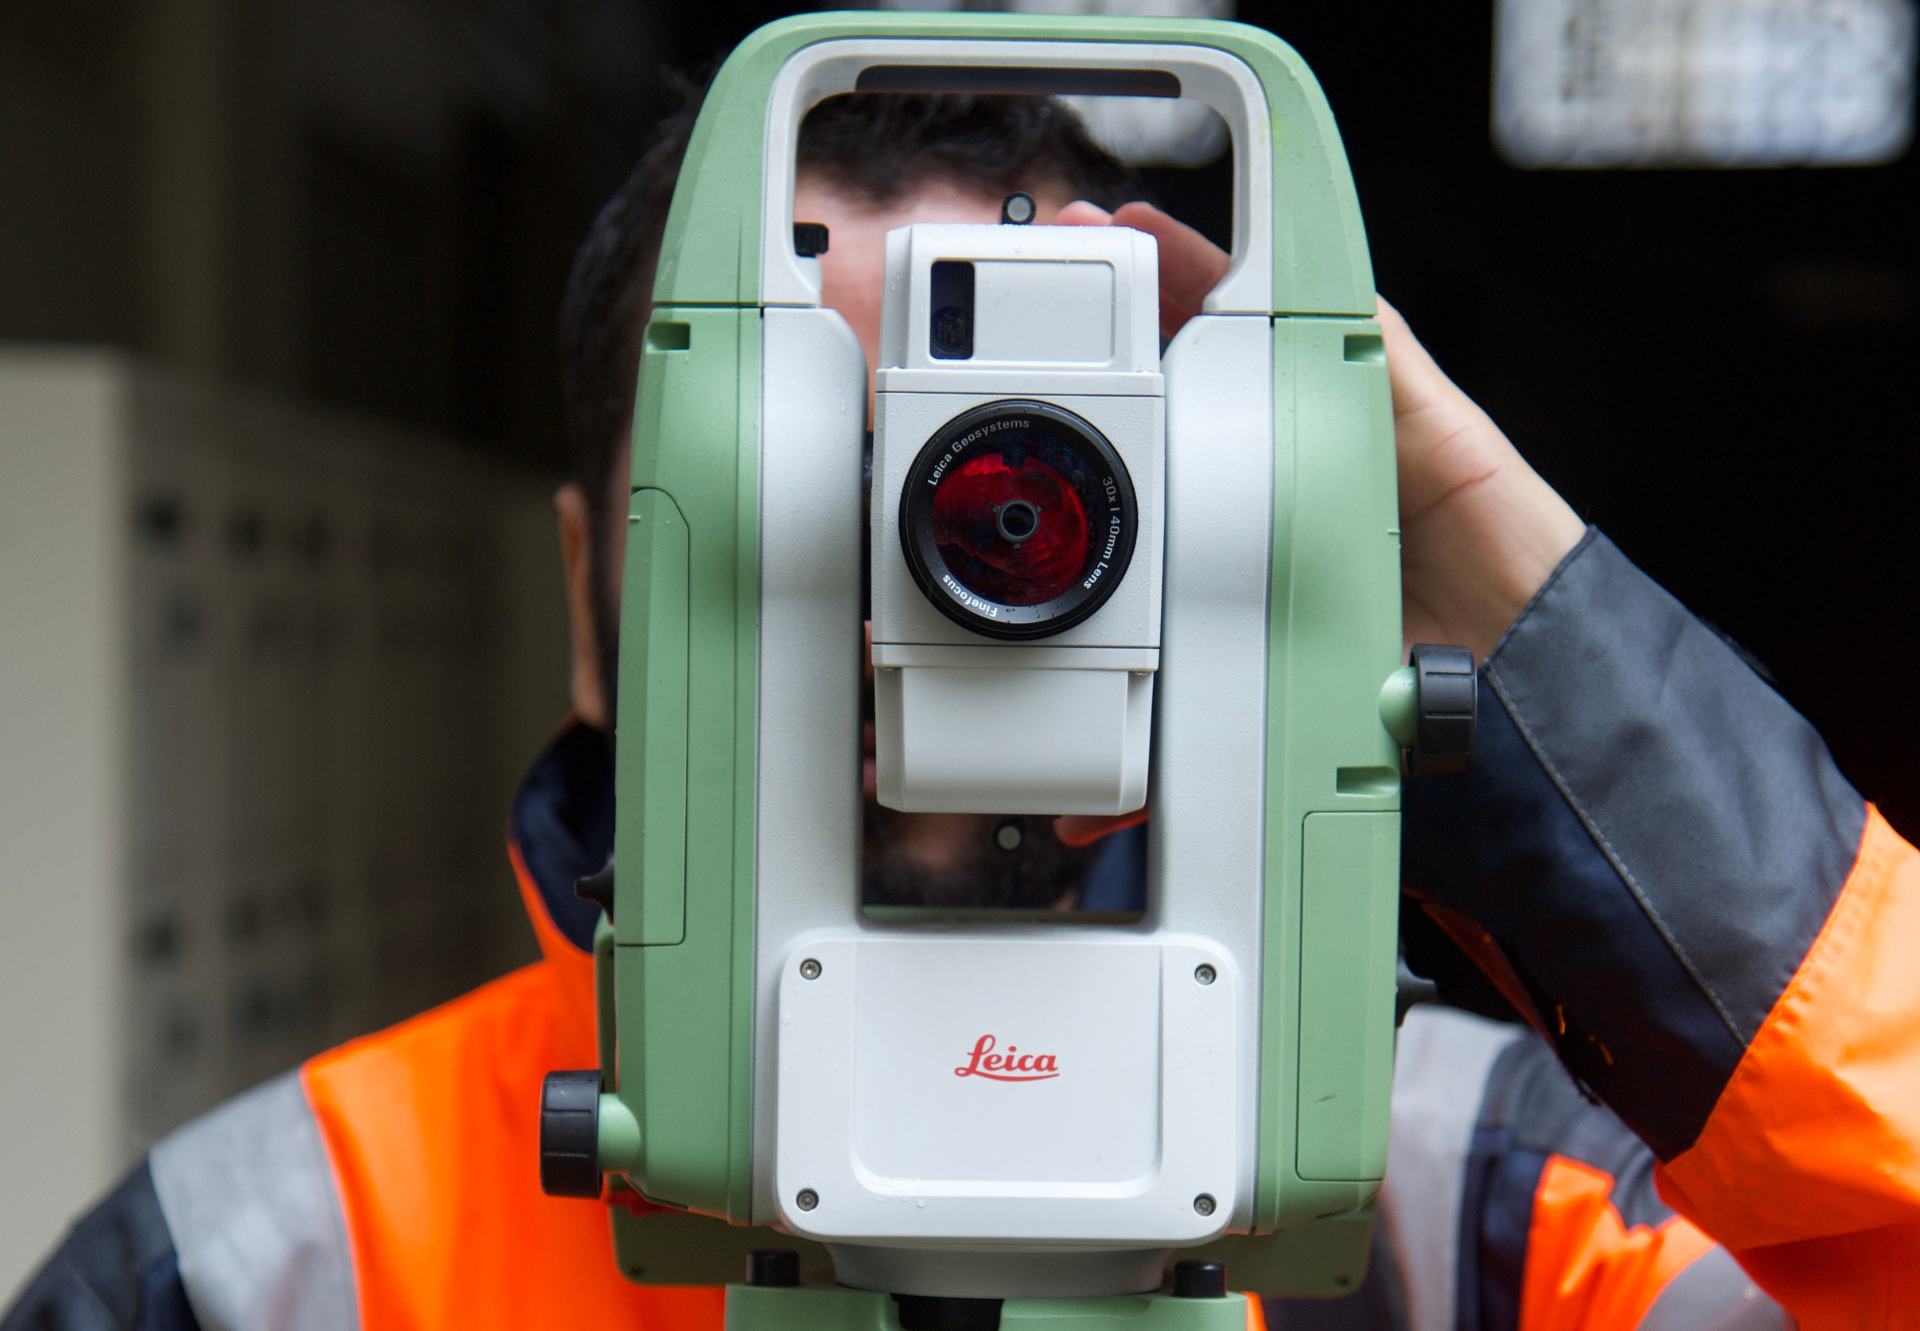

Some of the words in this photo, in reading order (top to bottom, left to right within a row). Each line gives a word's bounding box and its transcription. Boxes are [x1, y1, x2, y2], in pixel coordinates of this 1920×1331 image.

[928, 453, 953, 486] Leica
[951, 420, 1030, 453] Geosystems
[1103, 476, 1117, 503] 30x
[1103, 516, 1120, 559] 40mm
[942, 574, 998, 617] Finefocus
[1083, 561, 1109, 589] Lens
[954, 1034, 1060, 1082] Leica
